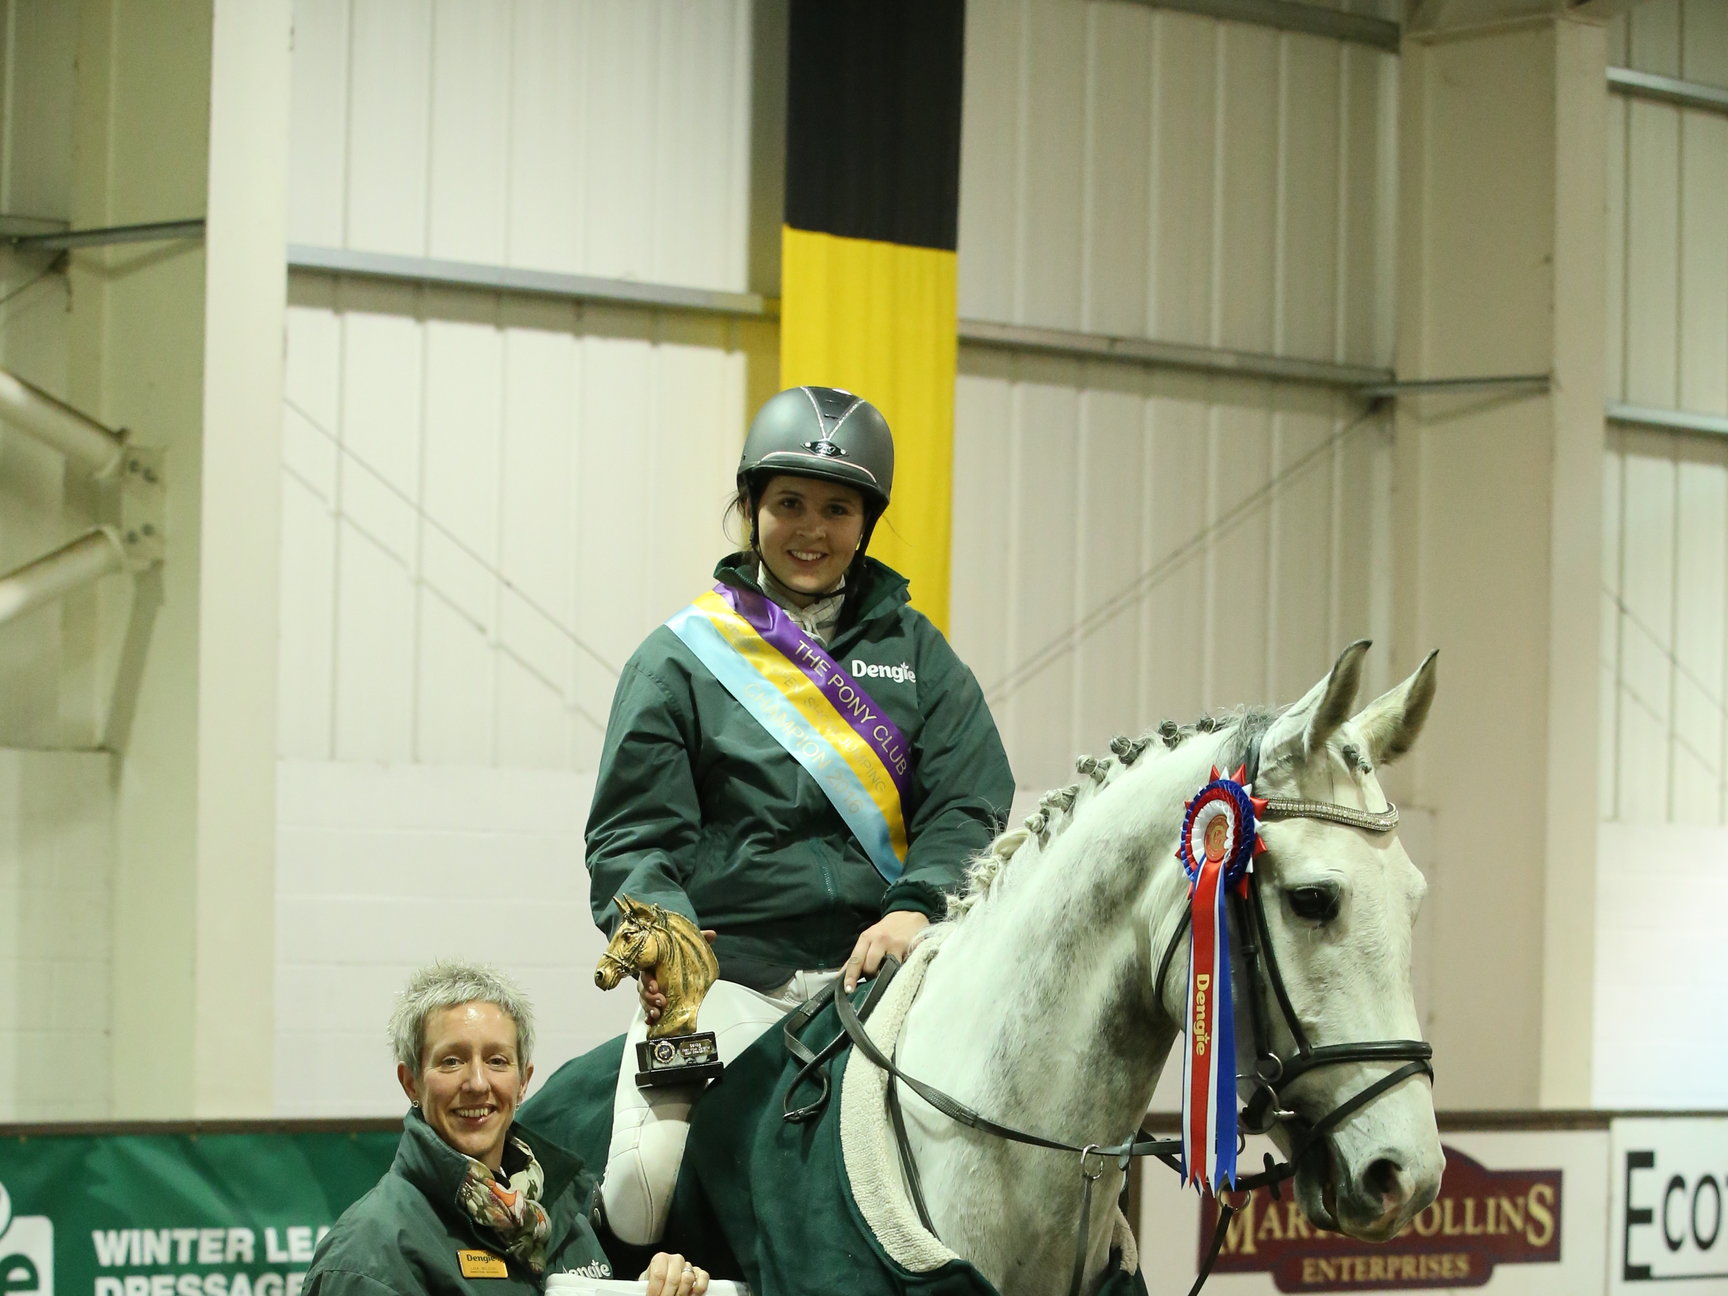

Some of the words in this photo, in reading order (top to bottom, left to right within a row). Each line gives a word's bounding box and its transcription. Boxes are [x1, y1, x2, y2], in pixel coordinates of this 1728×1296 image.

[852, 660, 916, 683] Dengie
[743, 682, 832, 769] CHAMPION
[795, 640, 831, 677] THE
[827, 673, 877, 724] PONY
[873, 725, 907, 775] CLUB
[1193, 974, 1210, 1056] Dengie
[1399, 1184, 1554, 1247] OLLINS
[92, 1227, 255, 1266] WINTER
[466, 1254, 496, 1263] Dengie
[562, 1260, 611, 1279] engie
[1303, 1254, 1470, 1284] ENTERPRISES
